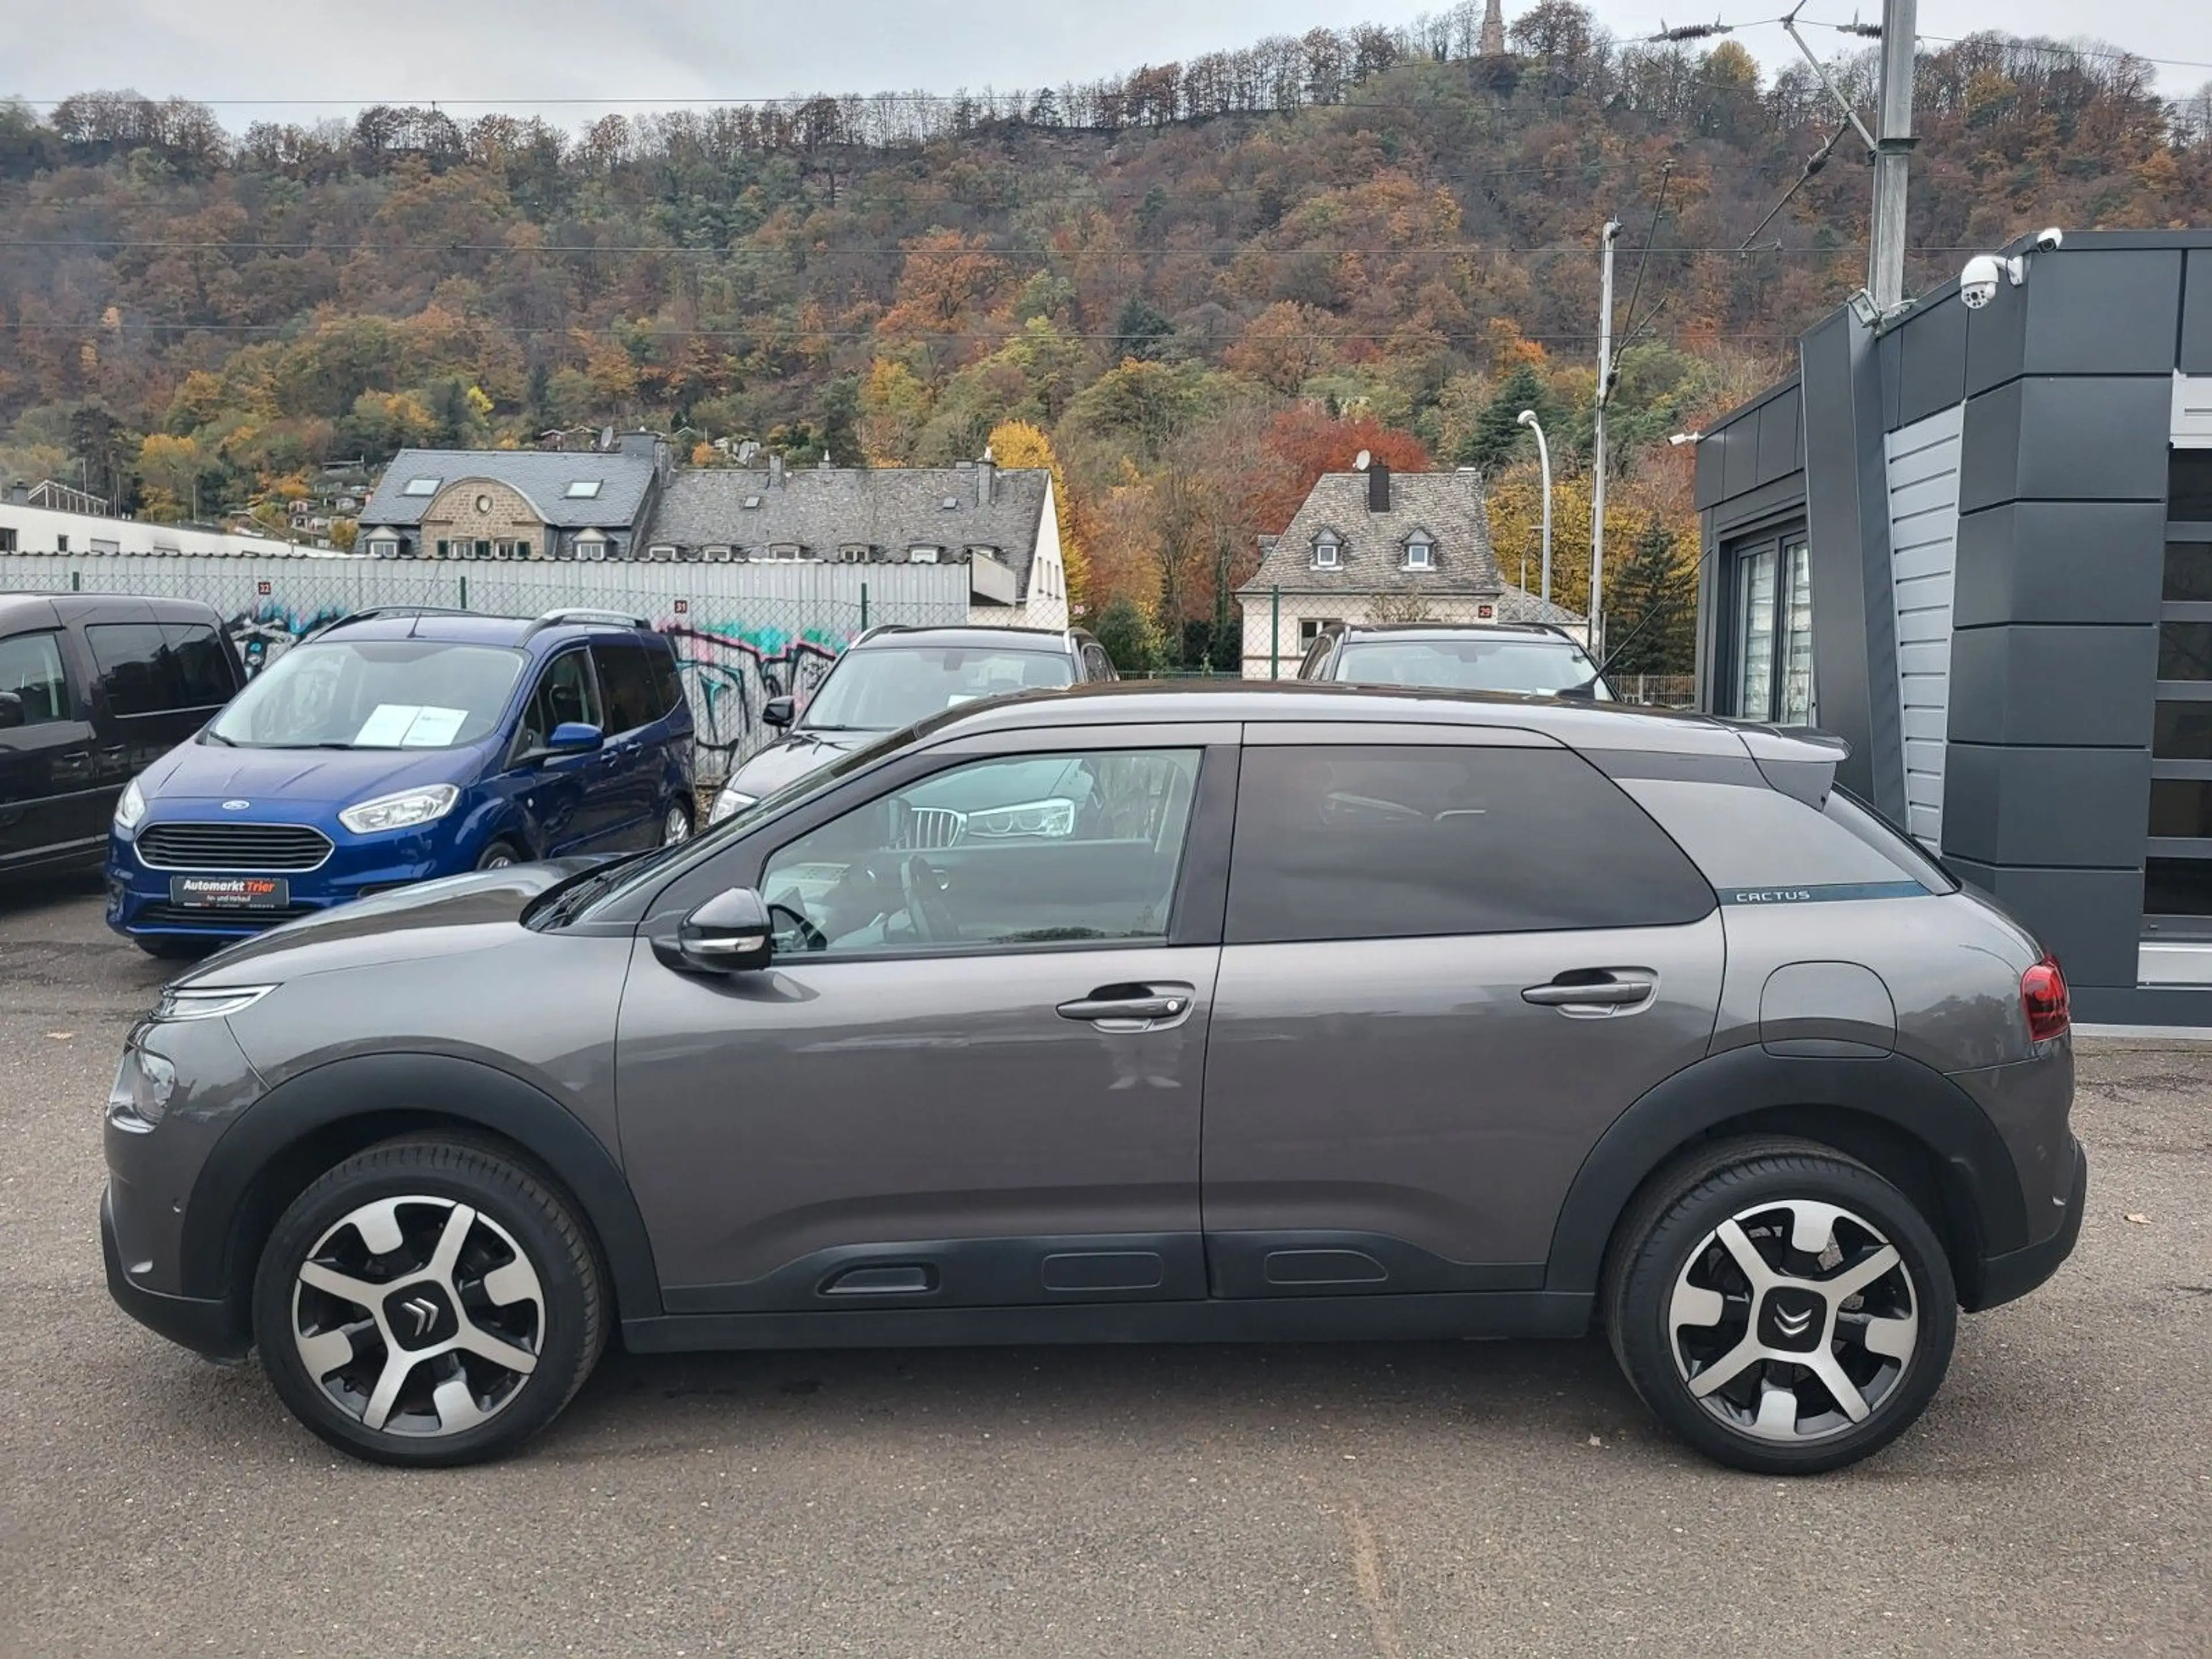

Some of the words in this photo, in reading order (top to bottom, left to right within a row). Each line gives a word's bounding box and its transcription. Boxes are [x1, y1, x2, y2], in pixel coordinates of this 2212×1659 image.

[260, 584, 270, 592] 32
[676, 602, 685, 611] 31
[184, 879, 245, 891] Automarkt
[247, 881, 275, 892] Trier
[1736, 891, 1810, 902] CACTUS
